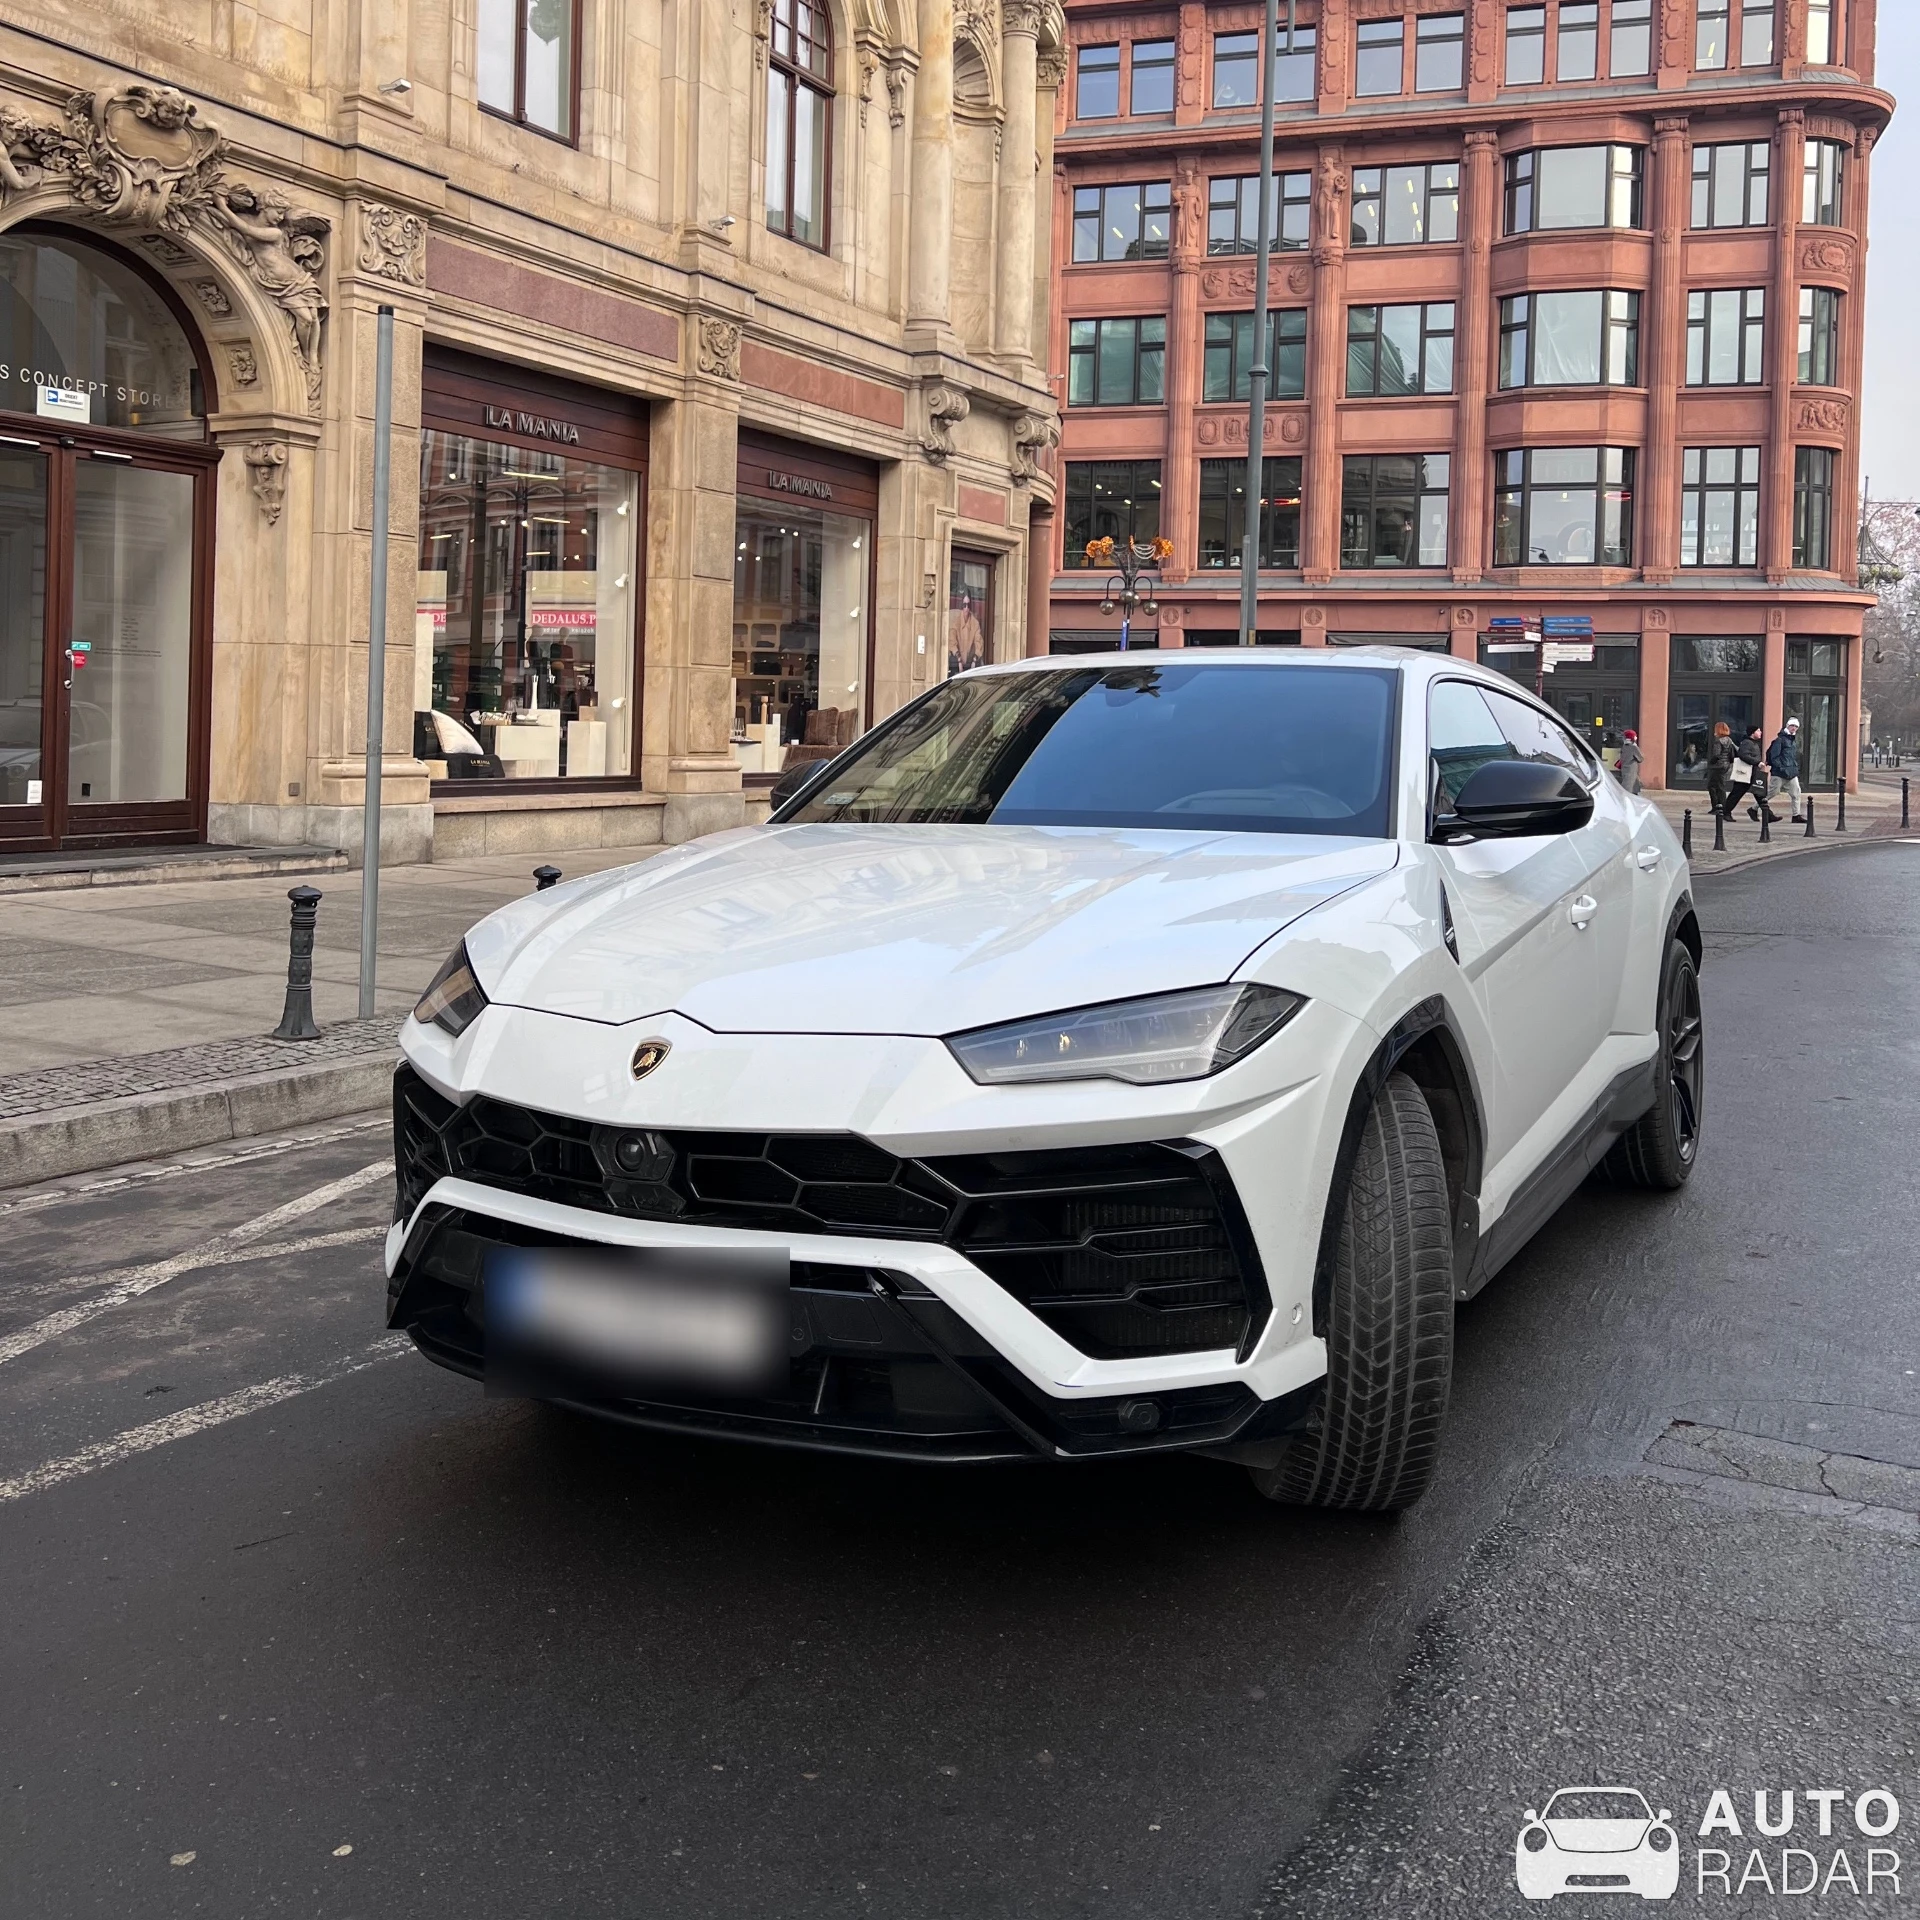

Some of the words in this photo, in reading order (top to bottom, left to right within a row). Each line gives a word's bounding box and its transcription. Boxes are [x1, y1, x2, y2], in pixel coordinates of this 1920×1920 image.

[20, 368, 108, 398] CONCEPT
[486, 405, 512, 430] LA
[516, 412, 580, 444] MANIA
[769, 470, 788, 491] LA
[789, 475, 833, 500] MANIA
